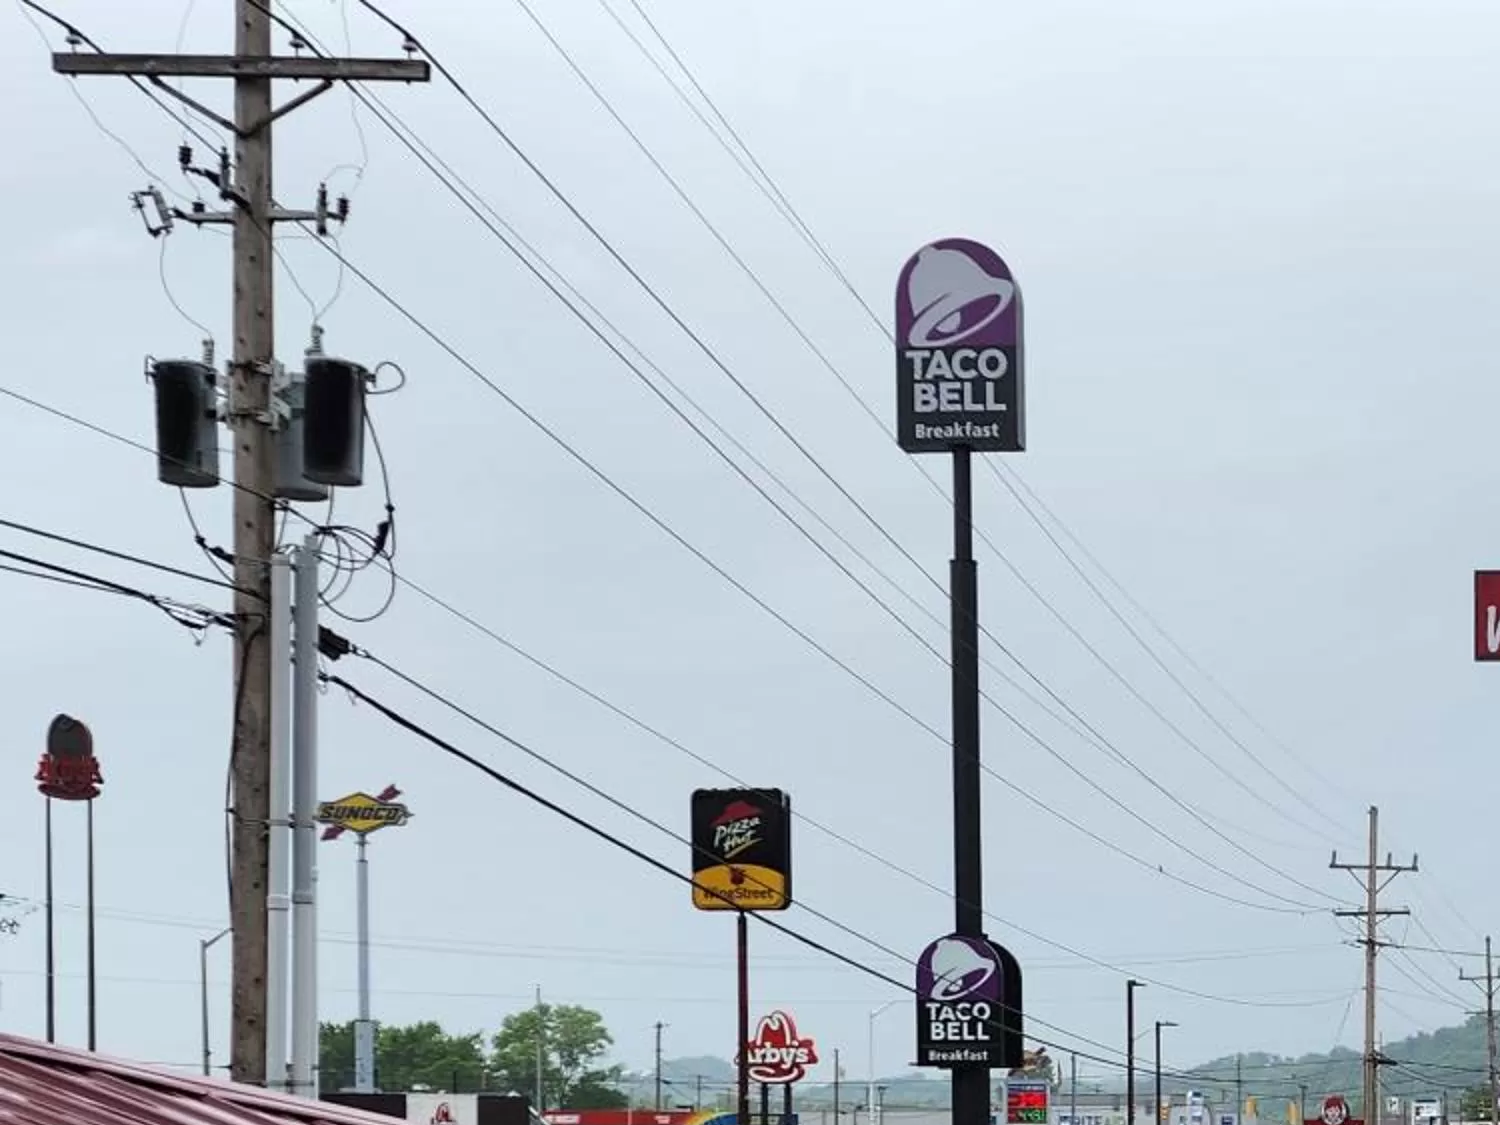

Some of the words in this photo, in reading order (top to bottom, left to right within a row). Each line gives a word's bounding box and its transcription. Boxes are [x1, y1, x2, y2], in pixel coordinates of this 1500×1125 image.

[905, 348, 1008, 380] TACO
[913, 381, 1007, 412] BELL
[915, 421, 1000, 439] Breakfast
[926, 1002, 991, 1021] TACO
[930, 1022, 990, 1041] BELL
[928, 1050, 989, 1061] Breakfast
